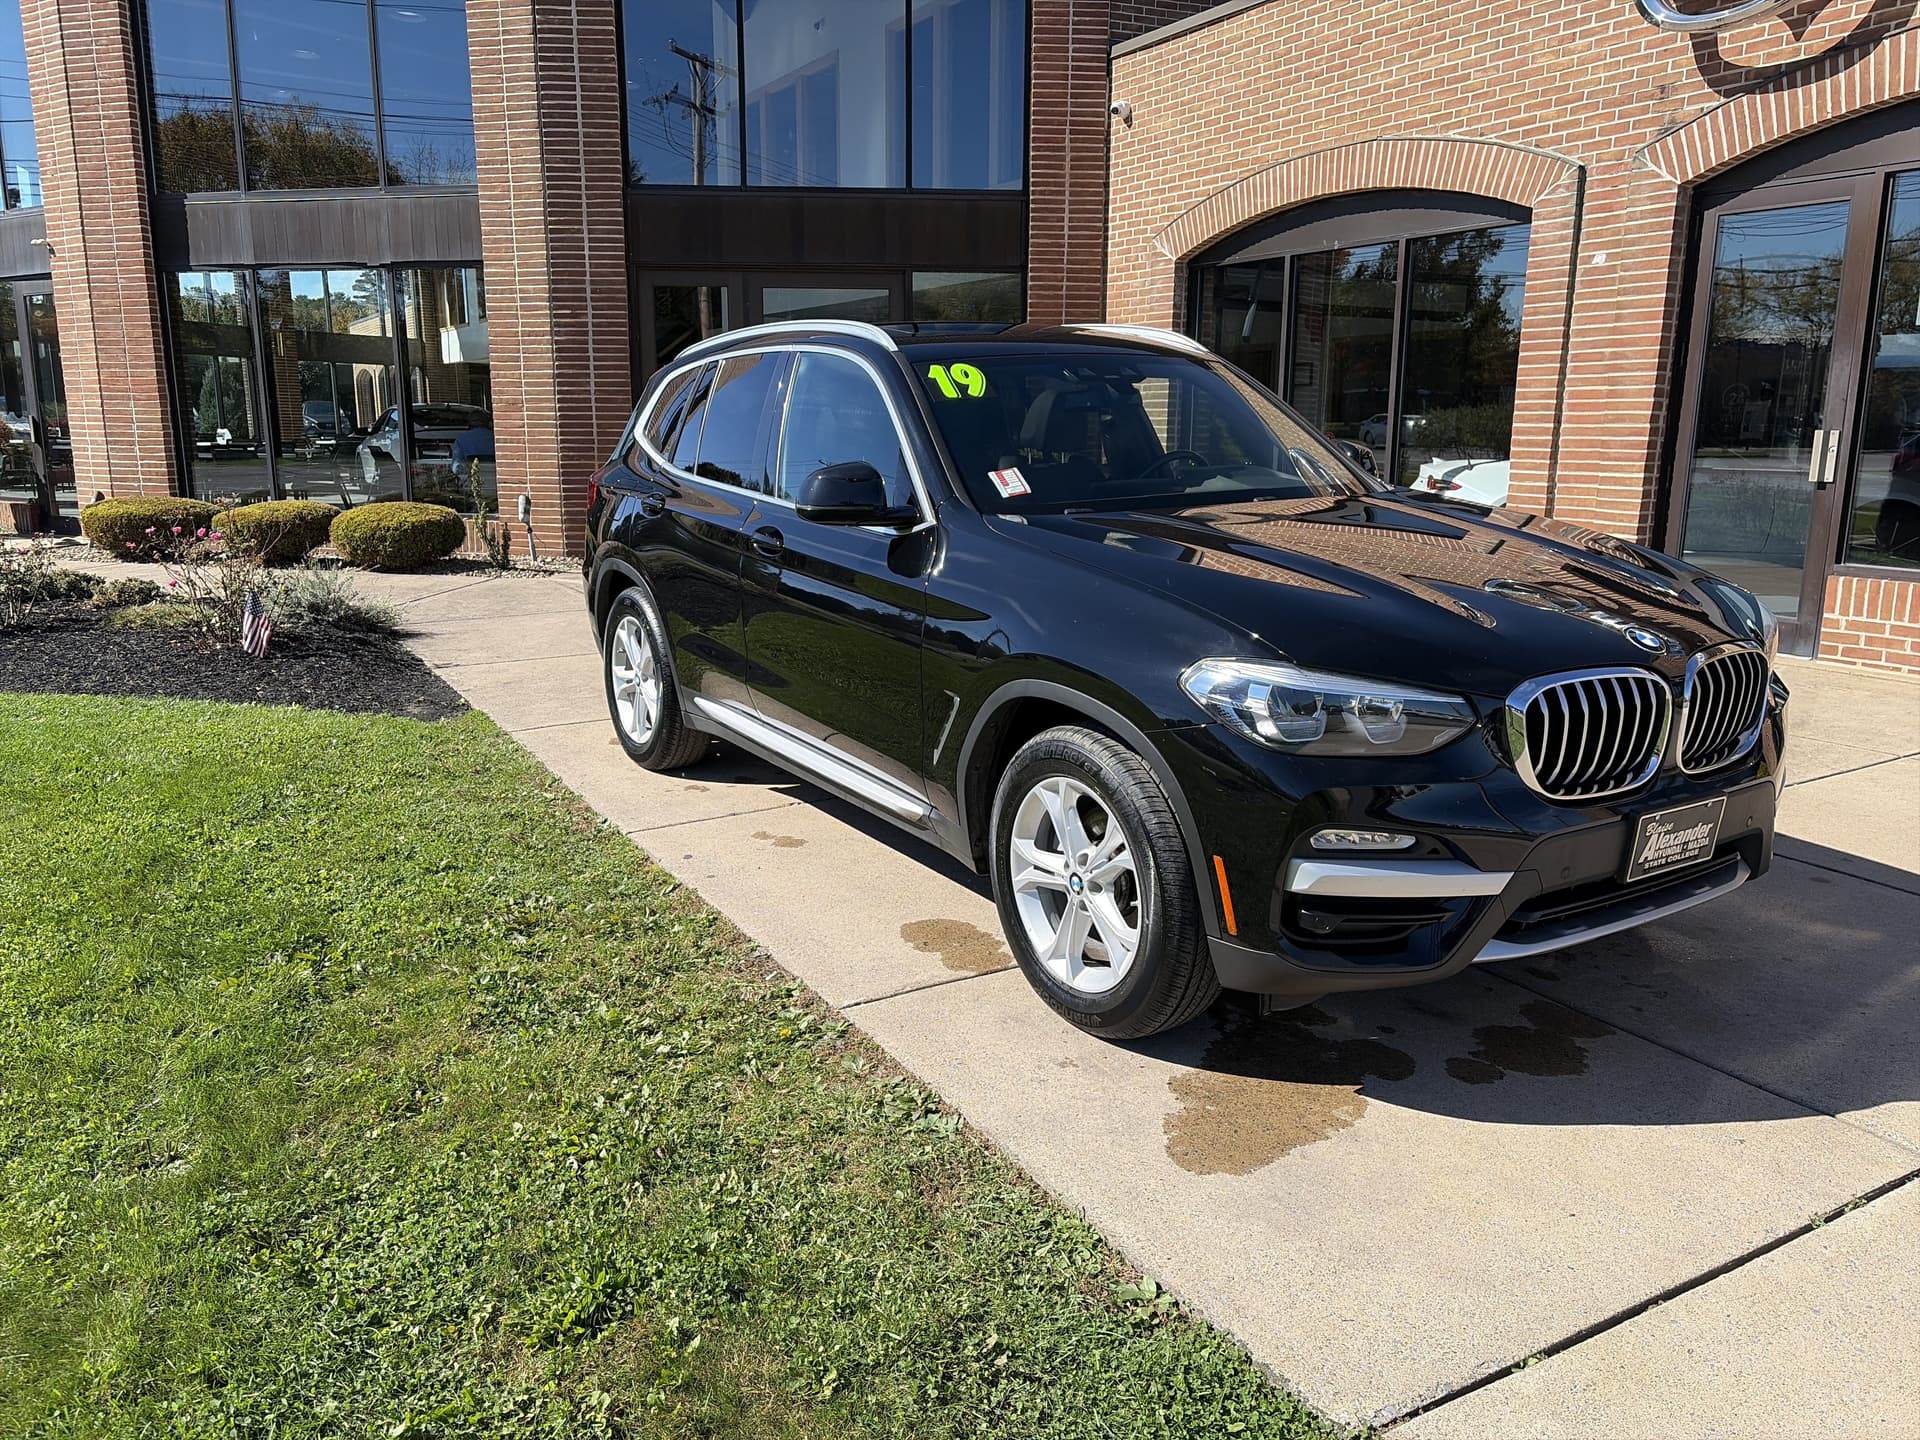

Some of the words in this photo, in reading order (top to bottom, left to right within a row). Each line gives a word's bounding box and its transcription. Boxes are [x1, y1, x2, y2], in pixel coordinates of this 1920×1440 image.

[928, 363, 986, 398] 19
[1646, 822, 1674, 836] Blaise
[1638, 822, 1714, 864] Alexander
[1654, 843, 1682, 859] HYUNDAI
[1687, 837, 1709, 850] MAZDA
[1643, 858, 1666, 869] STATE
[1667, 848, 1700, 863] COLLEGE
